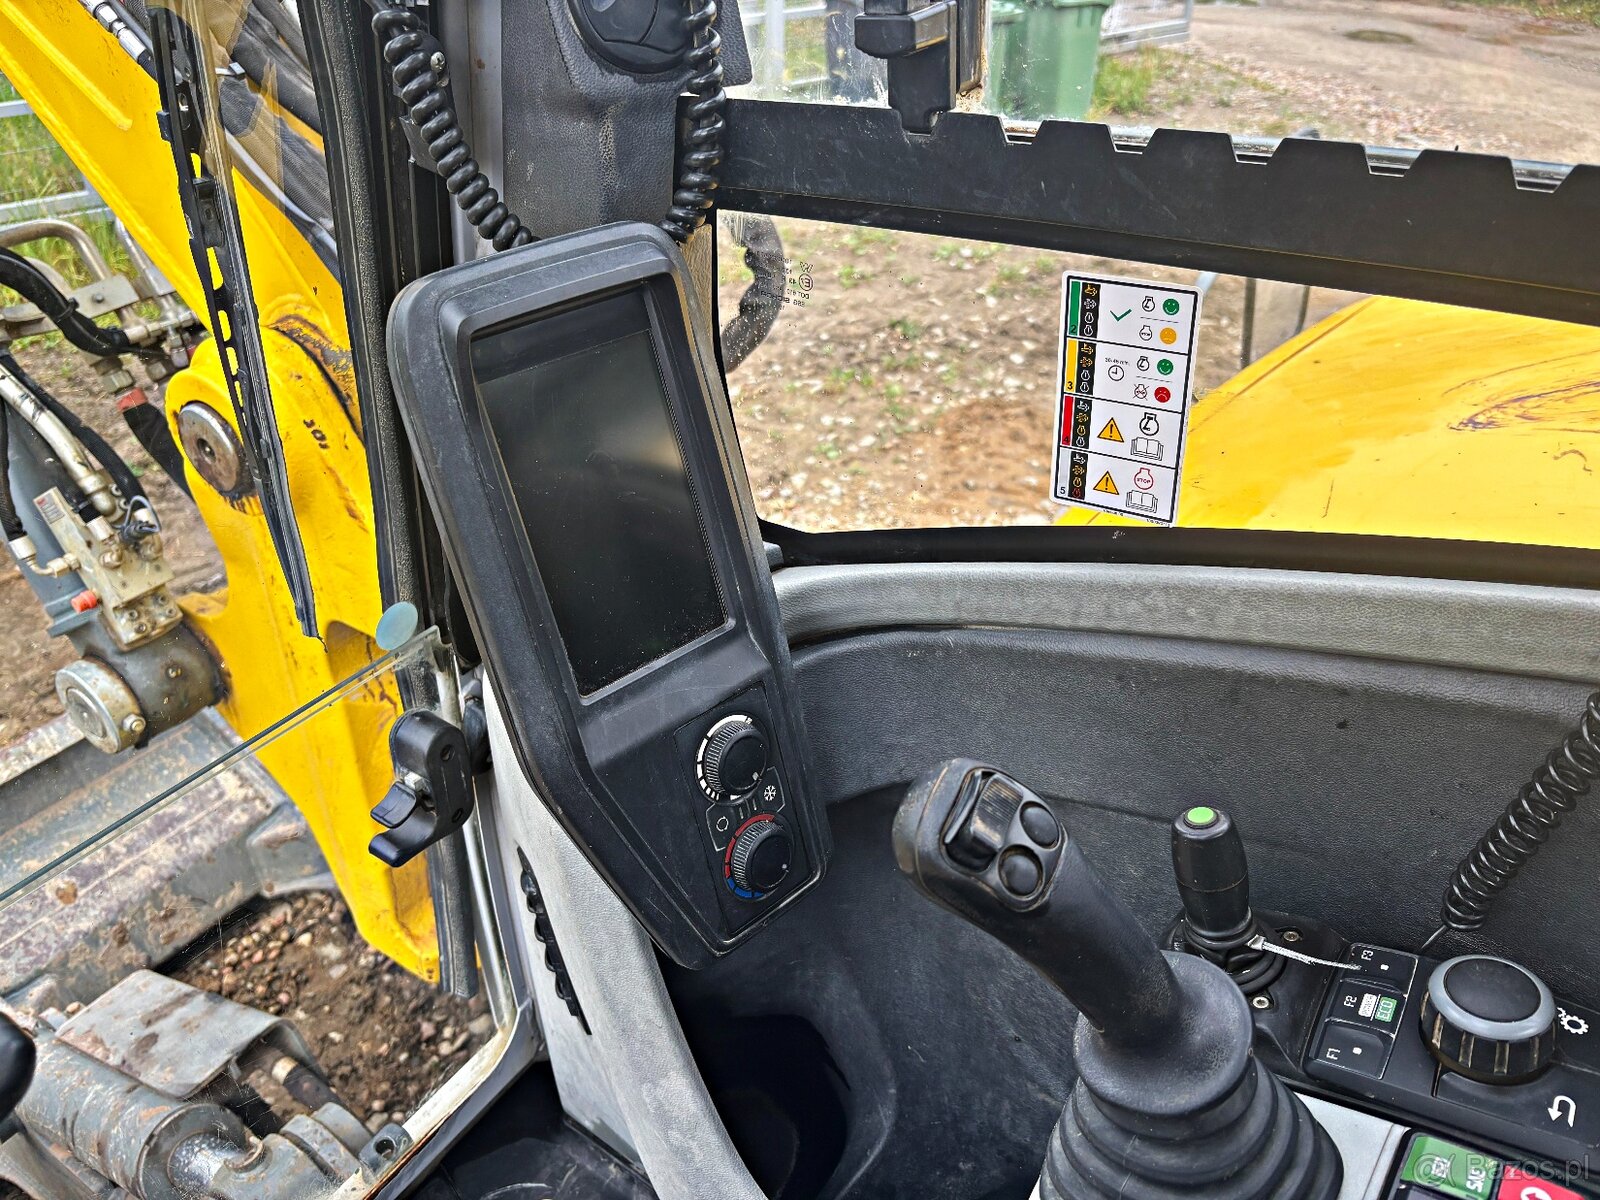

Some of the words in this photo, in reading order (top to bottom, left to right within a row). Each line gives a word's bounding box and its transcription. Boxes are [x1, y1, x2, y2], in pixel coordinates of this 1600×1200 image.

[1070, 325, 1077, 334] 2
[1067, 381, 1073, 390] 3
[1063, 436, 1070, 444] 4
[1136, 477, 1151, 485] STOP
[1060, 486, 1066, 495] 5
[1361, 949, 1374, 961] F3
[1343, 995, 1358, 1008] F2
[1376, 1000, 1394, 1020] ECO
[1326, 1047, 1341, 1060] F1
